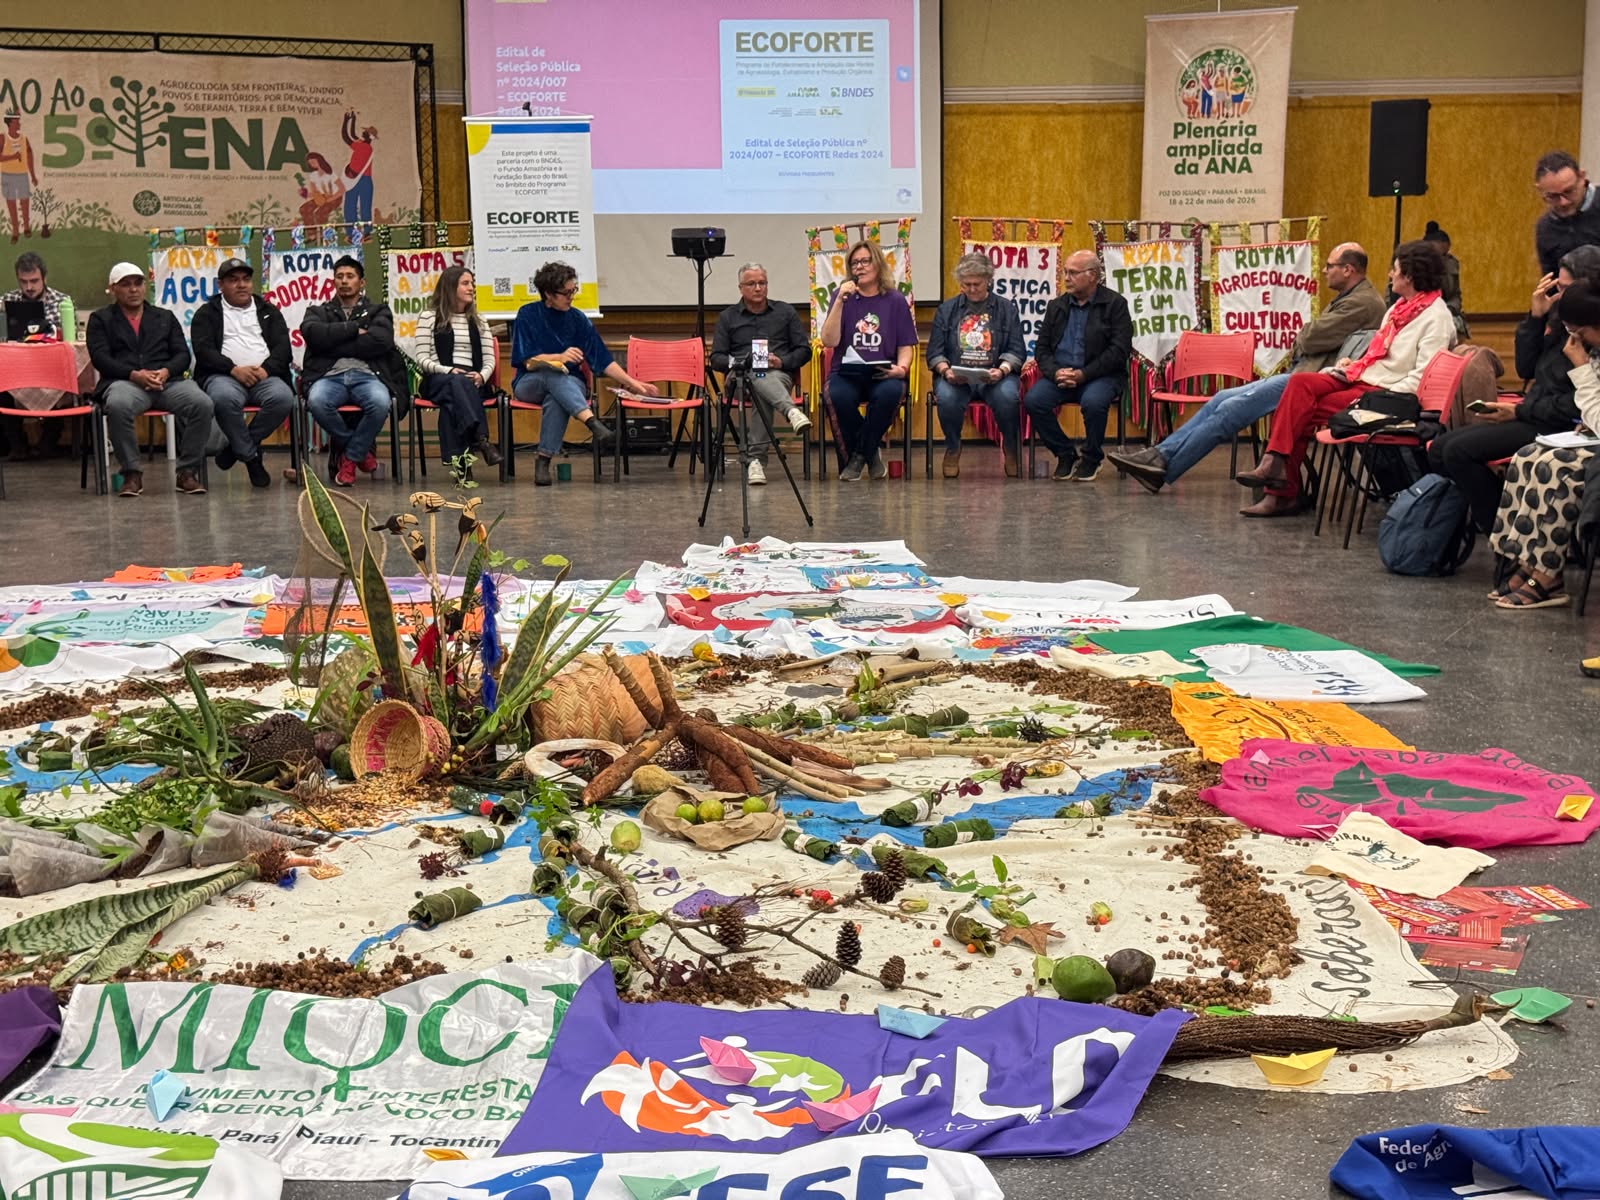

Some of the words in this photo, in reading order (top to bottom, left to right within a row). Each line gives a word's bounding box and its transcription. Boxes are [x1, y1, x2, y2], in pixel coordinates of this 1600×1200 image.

[495, 47, 530, 57] Edital
[531, 47, 545, 57] de
[735, 31, 875, 53] ECOFORTE
[495, 61, 538, 74] Seleção
[540, 60, 581, 72] Pública
[160, 79, 230, 92] AGROECOLOGIA
[231, 82, 250, 92] SEM
[252, 83, 306, 94] FRONTEIRAS,
[309, 86, 344, 96] UNINDO
[512, 76, 567, 88] 2024/007
[162, 91, 193, 101] POVOS
[194, 93, 199, 101] E
[264, 93, 281, 102] POR
[283, 93, 343, 106] DEMOCRACIA,
[507, 92, 567, 102] ECOFORTE
[841, 87, 874, 98] BNDES
[183, 103, 237, 113] SOBERANIA,
[239, 104, 267, 113] TERRA
[269, 105, 274, 113] E
[276, 104, 296, 114] BEM
[296, 106, 323, 116] VIVER
[1173, 120, 1257, 140] Plenária
[168, 115, 312, 173] ENA
[745, 138, 772, 148] Edital
[773, 139, 785, 148] de
[786, 138, 820, 149] Seleção
[821, 137, 855, 147] Pública
[1166, 138, 1263, 160] ampliada
[516, 150, 538, 158] projeto
[729, 151, 773, 160] 2024/007
[783, 151, 831, 159] ECOFORTE
[832, 150, 859, 159] Redes
[860, 151, 884, 159] 2024
[1174, 157, 1199, 175] da
[1205, 157, 1253, 174] ANA
[536, 181, 566, 189] Programa
[486, 211, 580, 225] ECOFORTE
[167, 248, 217, 270] ROTA
[282, 253, 335, 274] ROTA
[396, 252, 447, 273] ROTA
[452, 251, 465, 268] 5
[1037, 248, 1050, 270] 3
[1122, 244, 1171, 268] ROTA
[1234, 247, 1286, 270] ROTA
[161, 272, 221, 305] ÁGU
[398, 276, 411, 294] A
[1112, 265, 1188, 294] TERRA
[1212, 270, 1318, 297] AGROECOLOGIA
[263, 275, 337, 310] COOPER
[1261, 291, 1271, 305] E
[1133, 294, 1144, 314] É
[1150, 293, 1174, 310] UM
[1225, 310, 1304, 331] CULTURA
[853, 332, 882, 347] FLD
[1234, 330, 1297, 350] PULAR
[134, 1082, 316, 1104] MVIMENTO
[367, 1078, 534, 1105] INTERESTA
[14, 1089, 80, 1107] DAS
[483, 1105, 526, 1121] BA
[220, 1128, 279, 1145] Pará
[296, 1124, 368, 1147] Piauí
[388, 1133, 502, 1149] Tocantin
